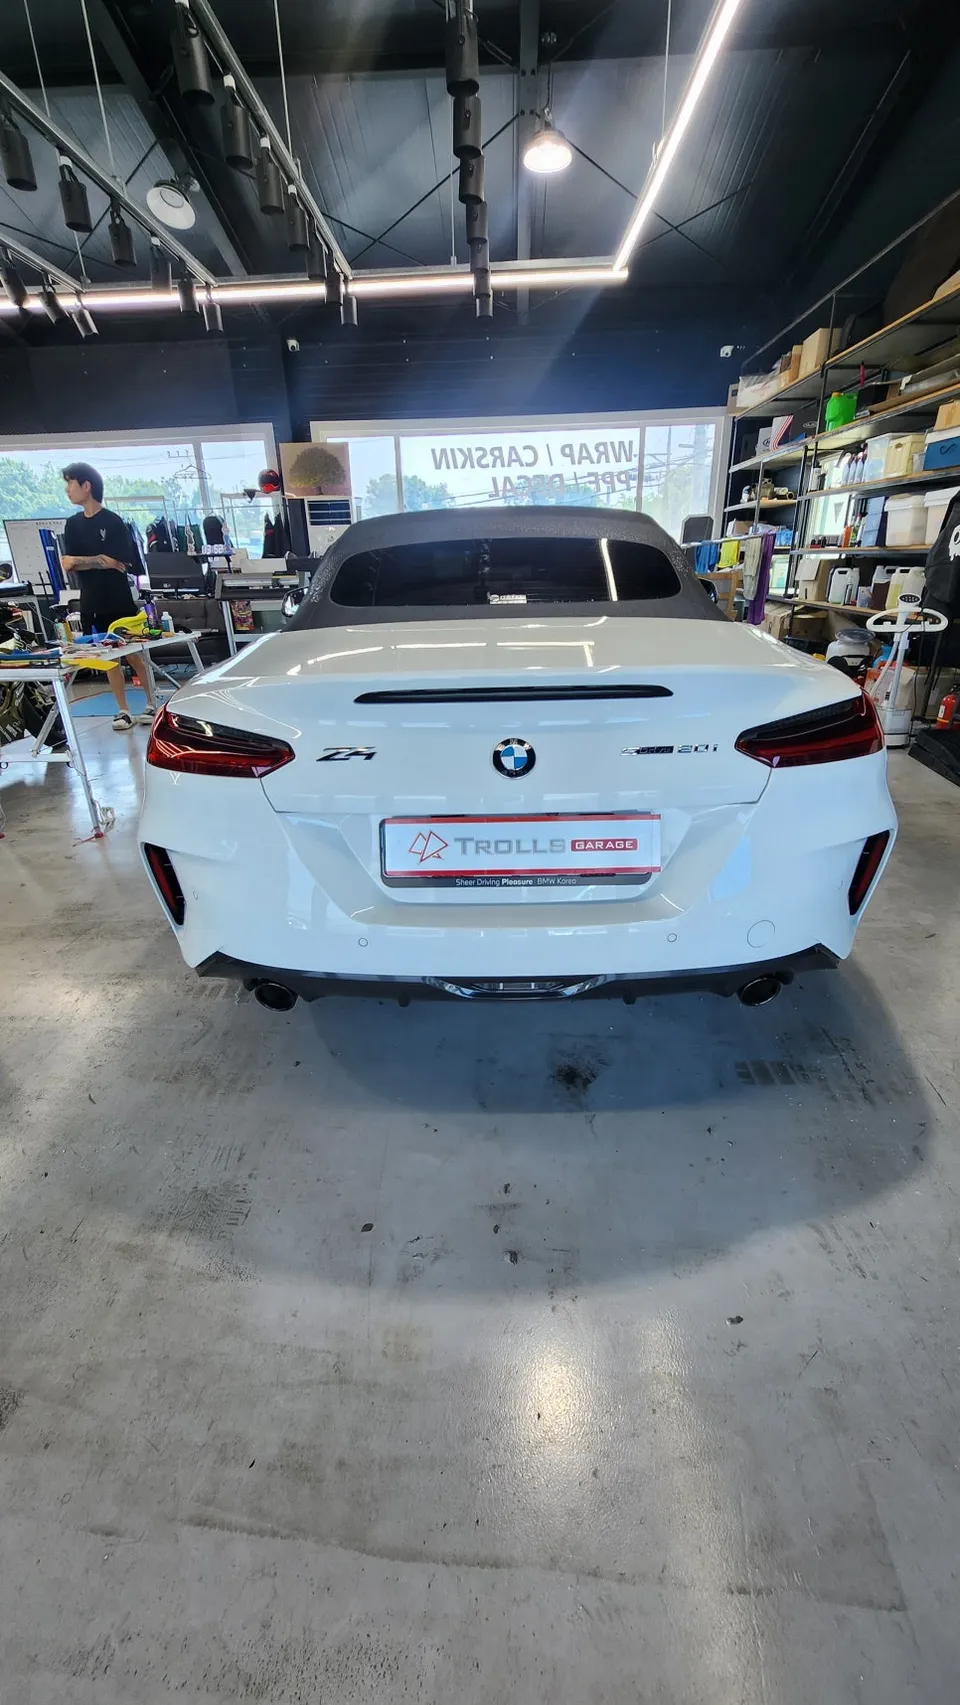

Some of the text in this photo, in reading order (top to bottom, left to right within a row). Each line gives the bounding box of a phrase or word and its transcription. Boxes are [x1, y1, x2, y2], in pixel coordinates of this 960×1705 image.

[316, 746, 378, 762] Z4
[454, 836, 634, 856] TROLLS GARAGE
[455, 877, 577, 887] Sheer Driving Pleasure BMW Korea
